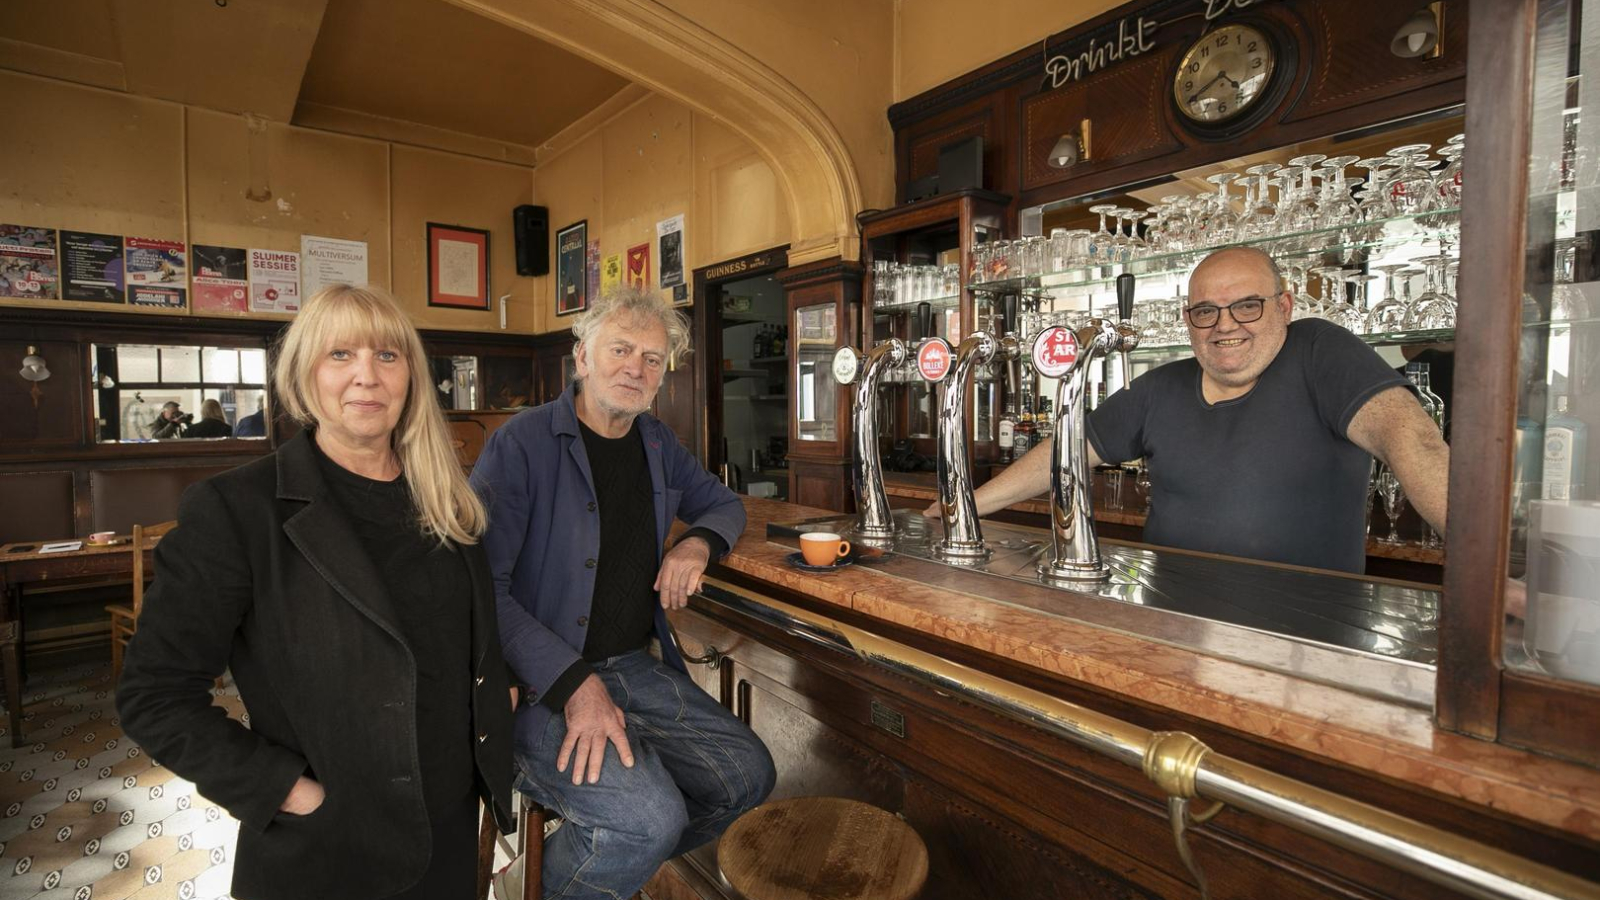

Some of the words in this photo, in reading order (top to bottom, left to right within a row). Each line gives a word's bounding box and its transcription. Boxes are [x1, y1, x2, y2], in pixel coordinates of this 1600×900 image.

[1215, 35, 1229, 48] 12
[1236, 34, 1242, 45] 1
[1045, 17, 1158, 88] Drinkt
[1201, 46, 1209, 58] 11
[1247, 41, 1257, 53] 2
[1188, 61, 1200, 74] 10
[1252, 57, 1262, 69] 3
[1185, 81, 1193, 92] 9
[1217, 102, 1227, 113] 6
[253, 251, 297, 263] SLUIMER
[308, 249, 363, 262] MULTIVERSUM
[253, 260, 297, 271] SESSIES
[706, 260, 747, 280] GUINNESS
